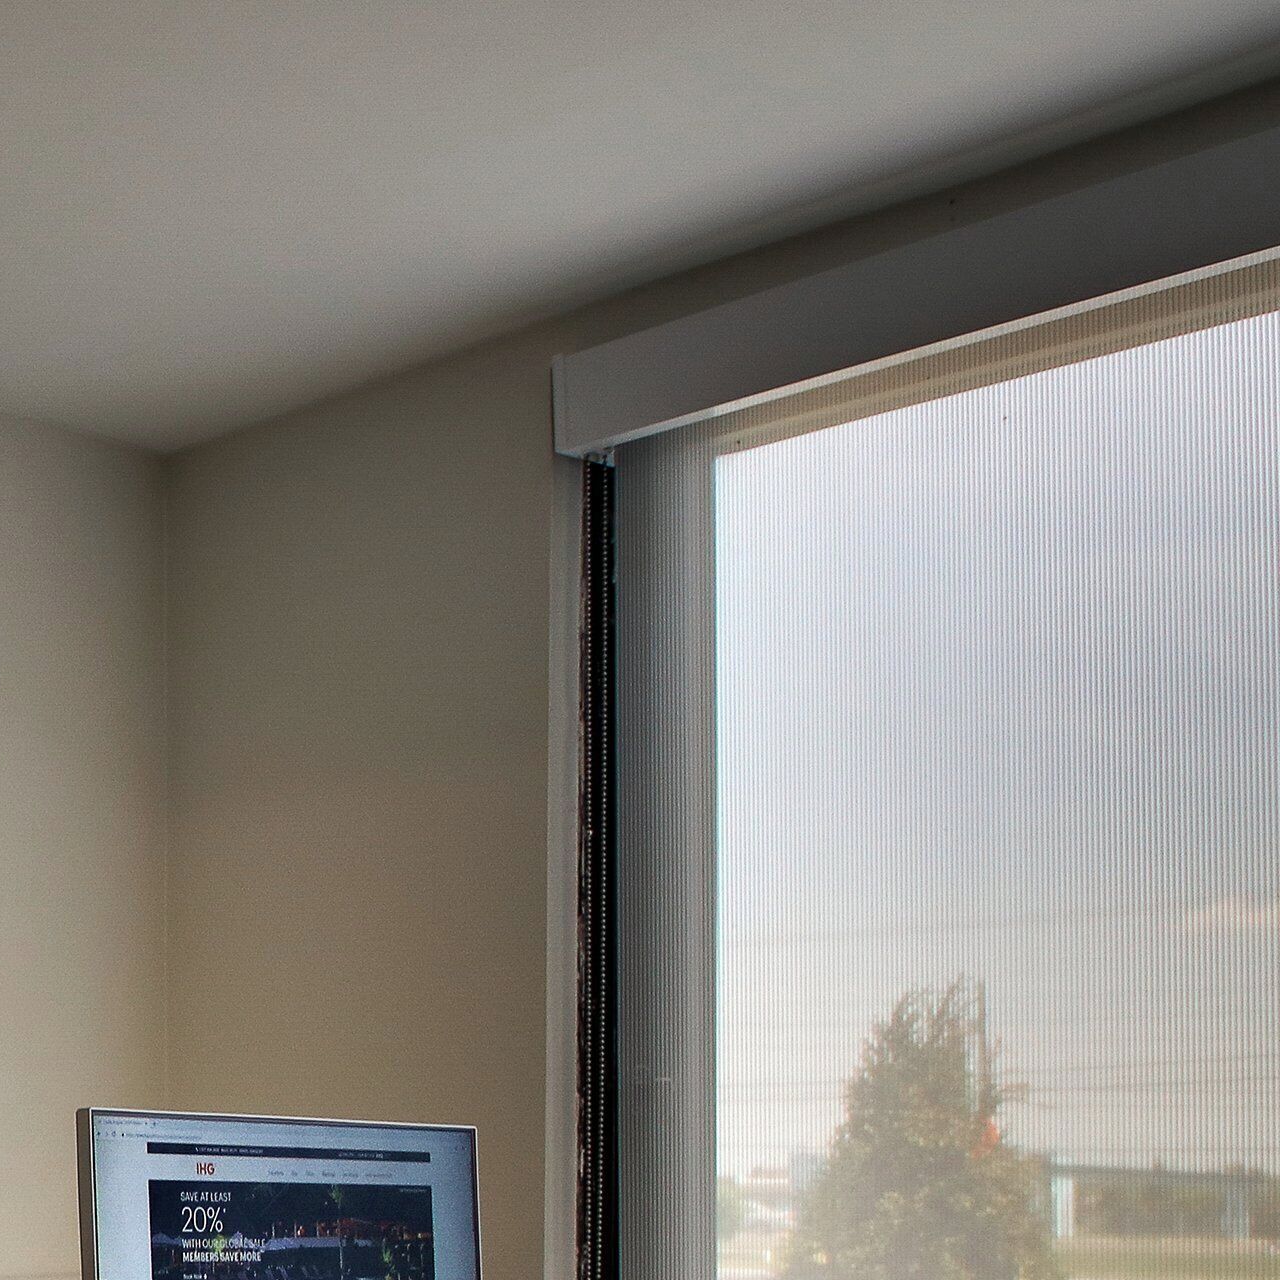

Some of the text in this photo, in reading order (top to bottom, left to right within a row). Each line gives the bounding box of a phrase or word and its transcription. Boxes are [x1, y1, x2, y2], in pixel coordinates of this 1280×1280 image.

[196, 1162, 215, 1176] IHG
[180, 1192, 232, 1202] SAVE AT LEAST
[182, 1238, 201, 1249] WITH
[182, 1250, 262, 1263] MEMBERS SAVE MORE
